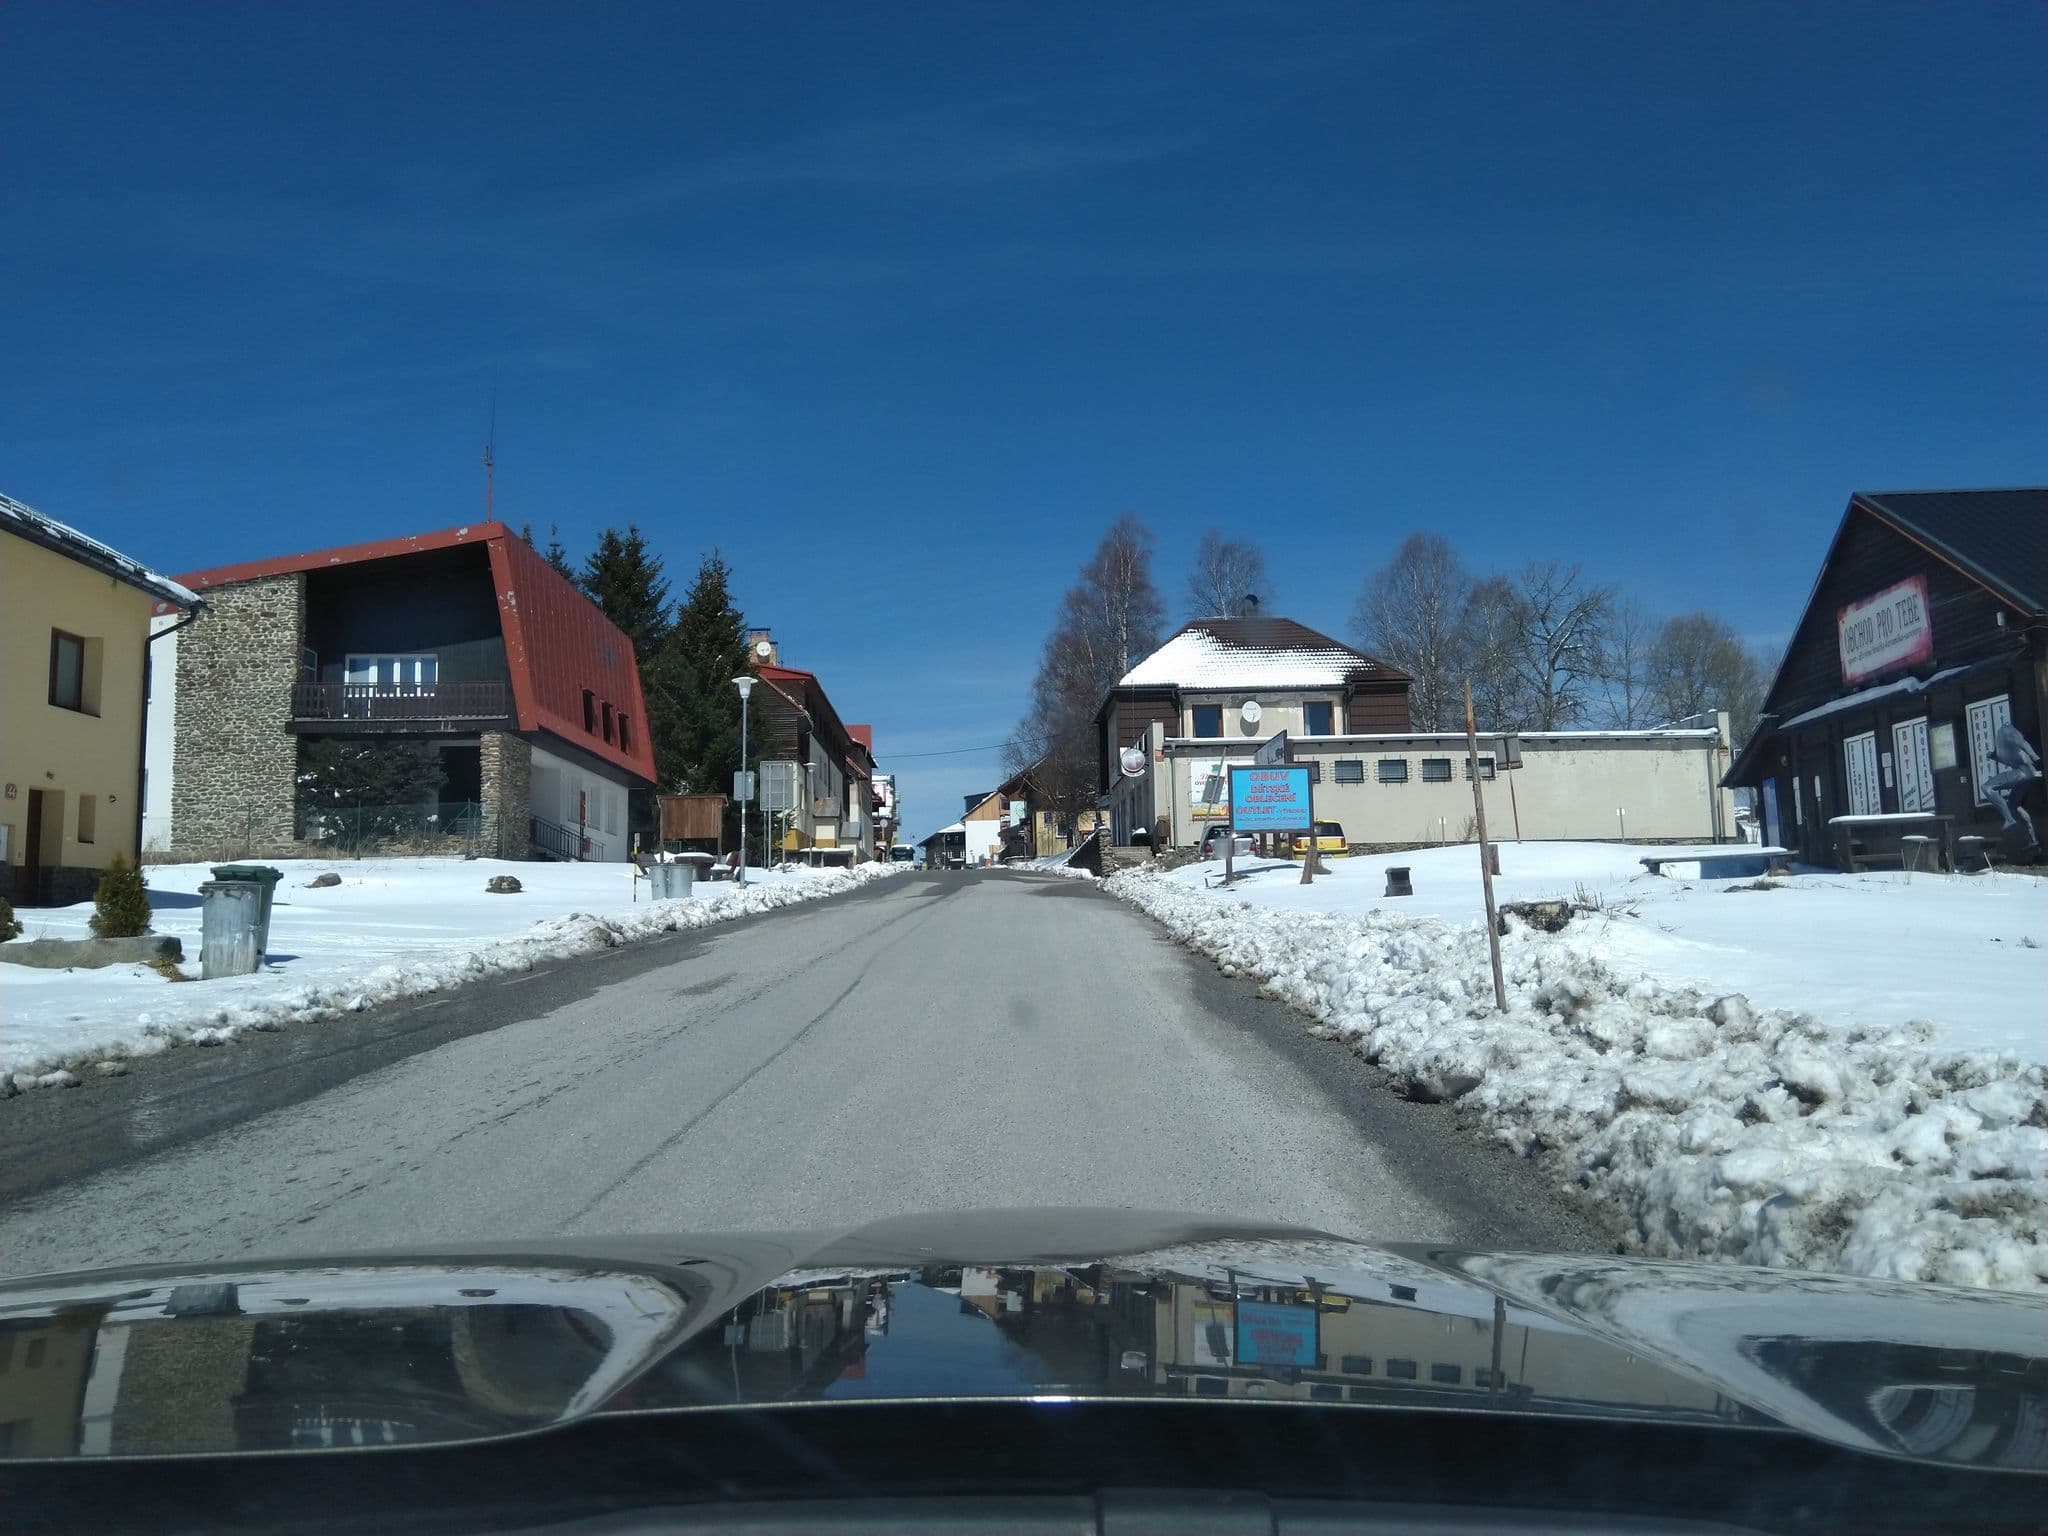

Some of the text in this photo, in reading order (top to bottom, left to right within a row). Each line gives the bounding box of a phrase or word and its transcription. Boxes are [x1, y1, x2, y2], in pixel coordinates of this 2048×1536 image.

[1843, 616, 1874, 654] OBCHOD
[1876, 607, 1893, 639] PRO
[1895, 594, 1920, 630] TEBE
[1250, 771, 1290, 781] OBUV
[1902, 730, 1911, 785] BOTY
